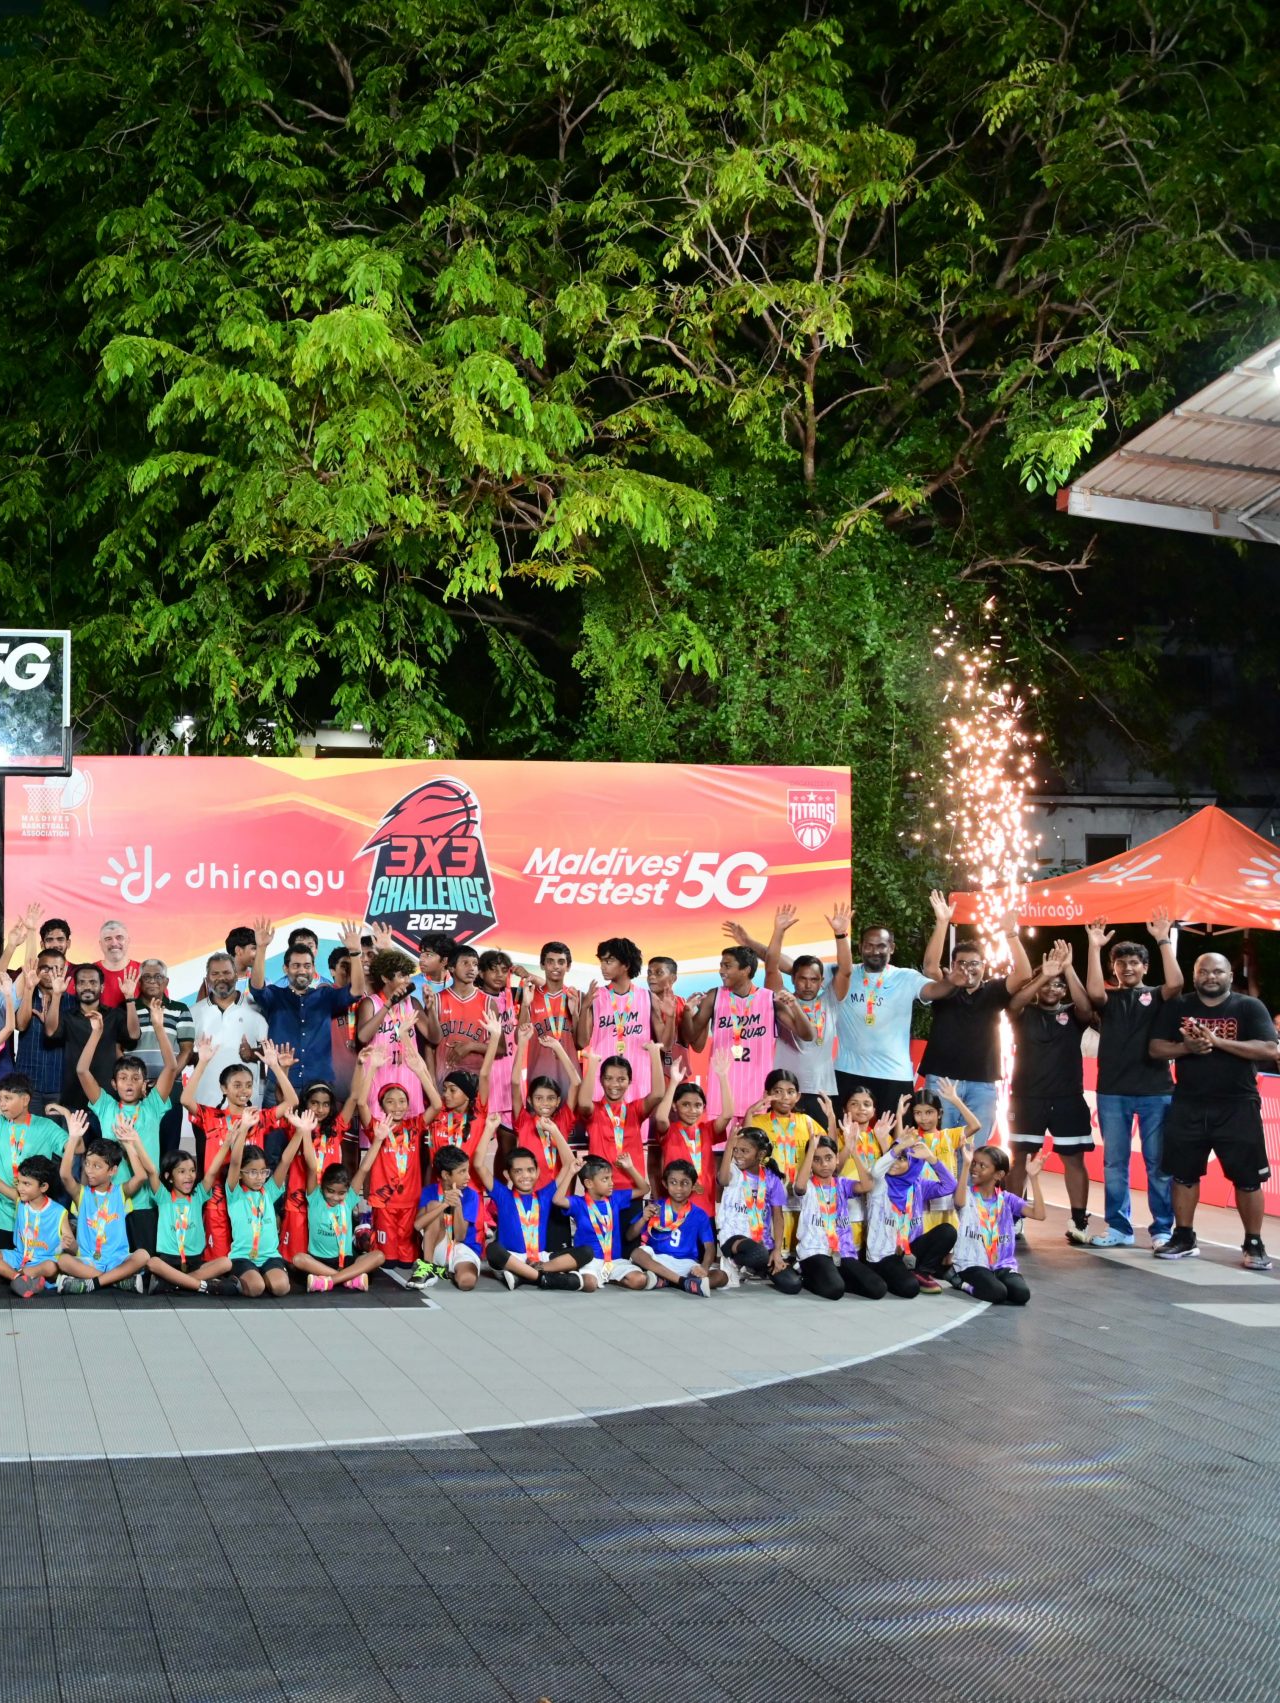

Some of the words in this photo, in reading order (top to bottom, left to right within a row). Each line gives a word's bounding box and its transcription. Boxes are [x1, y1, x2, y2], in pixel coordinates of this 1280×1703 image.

[789, 803, 835, 824] TITANS
[21, 822, 70, 830] BASKETBALL
[385, 837, 479, 876] 3X3
[185, 863, 345, 897] dhiraagu
[534, 875, 669, 906] Fastest
[675, 851, 769, 909] 5G
[369, 876, 493, 917] CHALLENGE
[407, 913, 458, 931] 2025
[440, 1021, 482, 1041] BULLS
[376, 1230, 387, 1245] 10
[670, 1228, 681, 1248] 9
